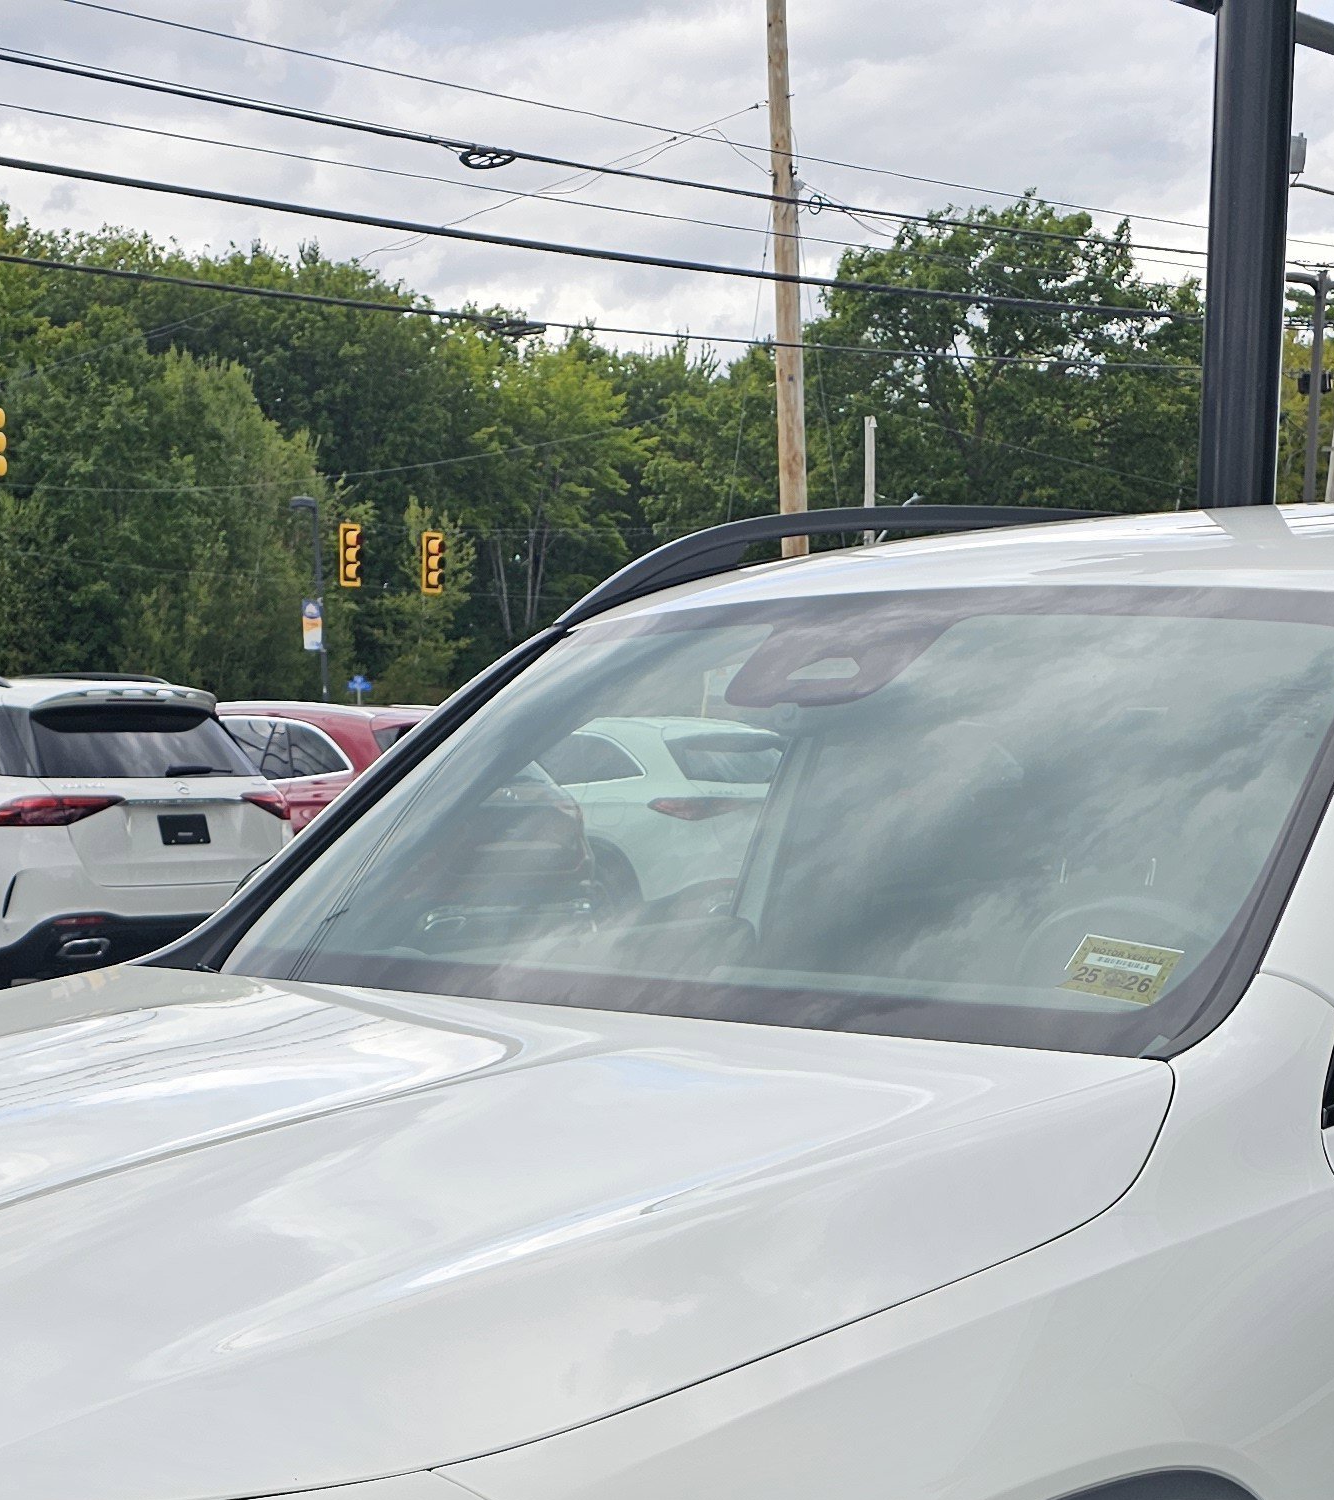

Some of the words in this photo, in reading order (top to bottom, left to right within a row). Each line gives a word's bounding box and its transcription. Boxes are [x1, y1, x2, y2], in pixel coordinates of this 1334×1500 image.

[1091, 946, 1125, 959] MOTOR
[1127, 952, 1165, 965] VEHICLE
[1072, 966, 1102, 983] 25
[1122, 975, 1153, 993] 26
